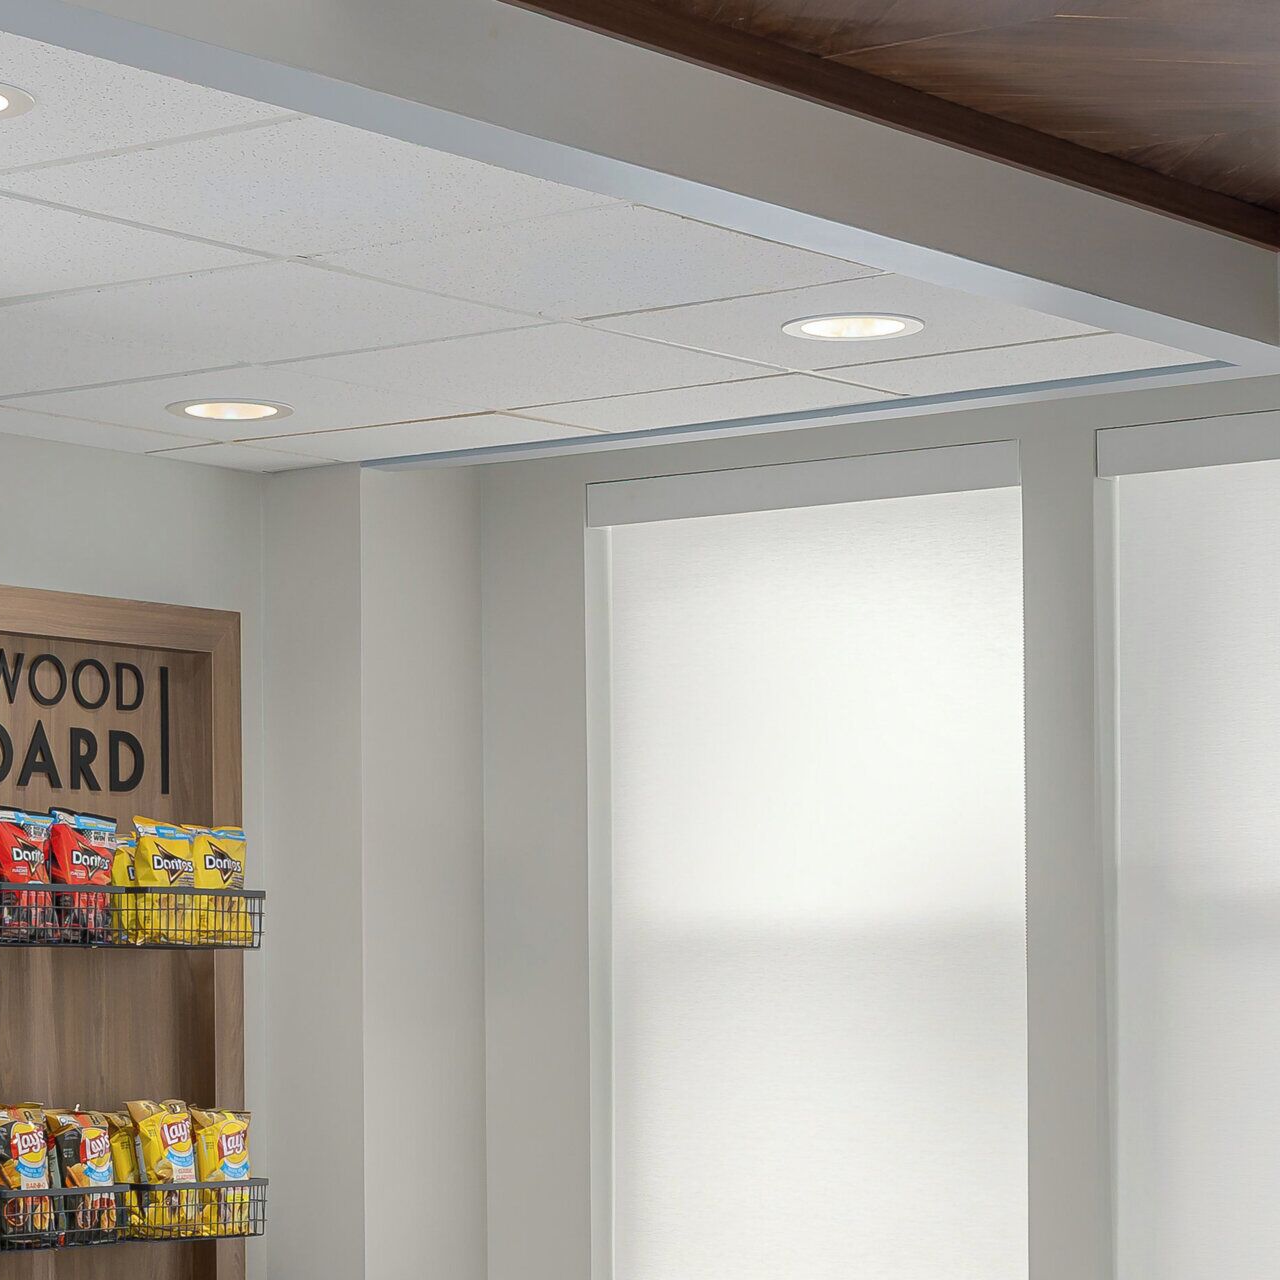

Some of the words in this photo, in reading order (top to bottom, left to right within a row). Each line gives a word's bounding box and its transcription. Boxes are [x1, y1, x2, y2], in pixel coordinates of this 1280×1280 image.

[72, 850, 111, 870] Doritos
[153, 855, 194, 872] Doritos
[205, 855, 242, 872] Doritos
[15, 1130, 45, 1157] Lay's
[85, 1134, 111, 1160] Lay's
